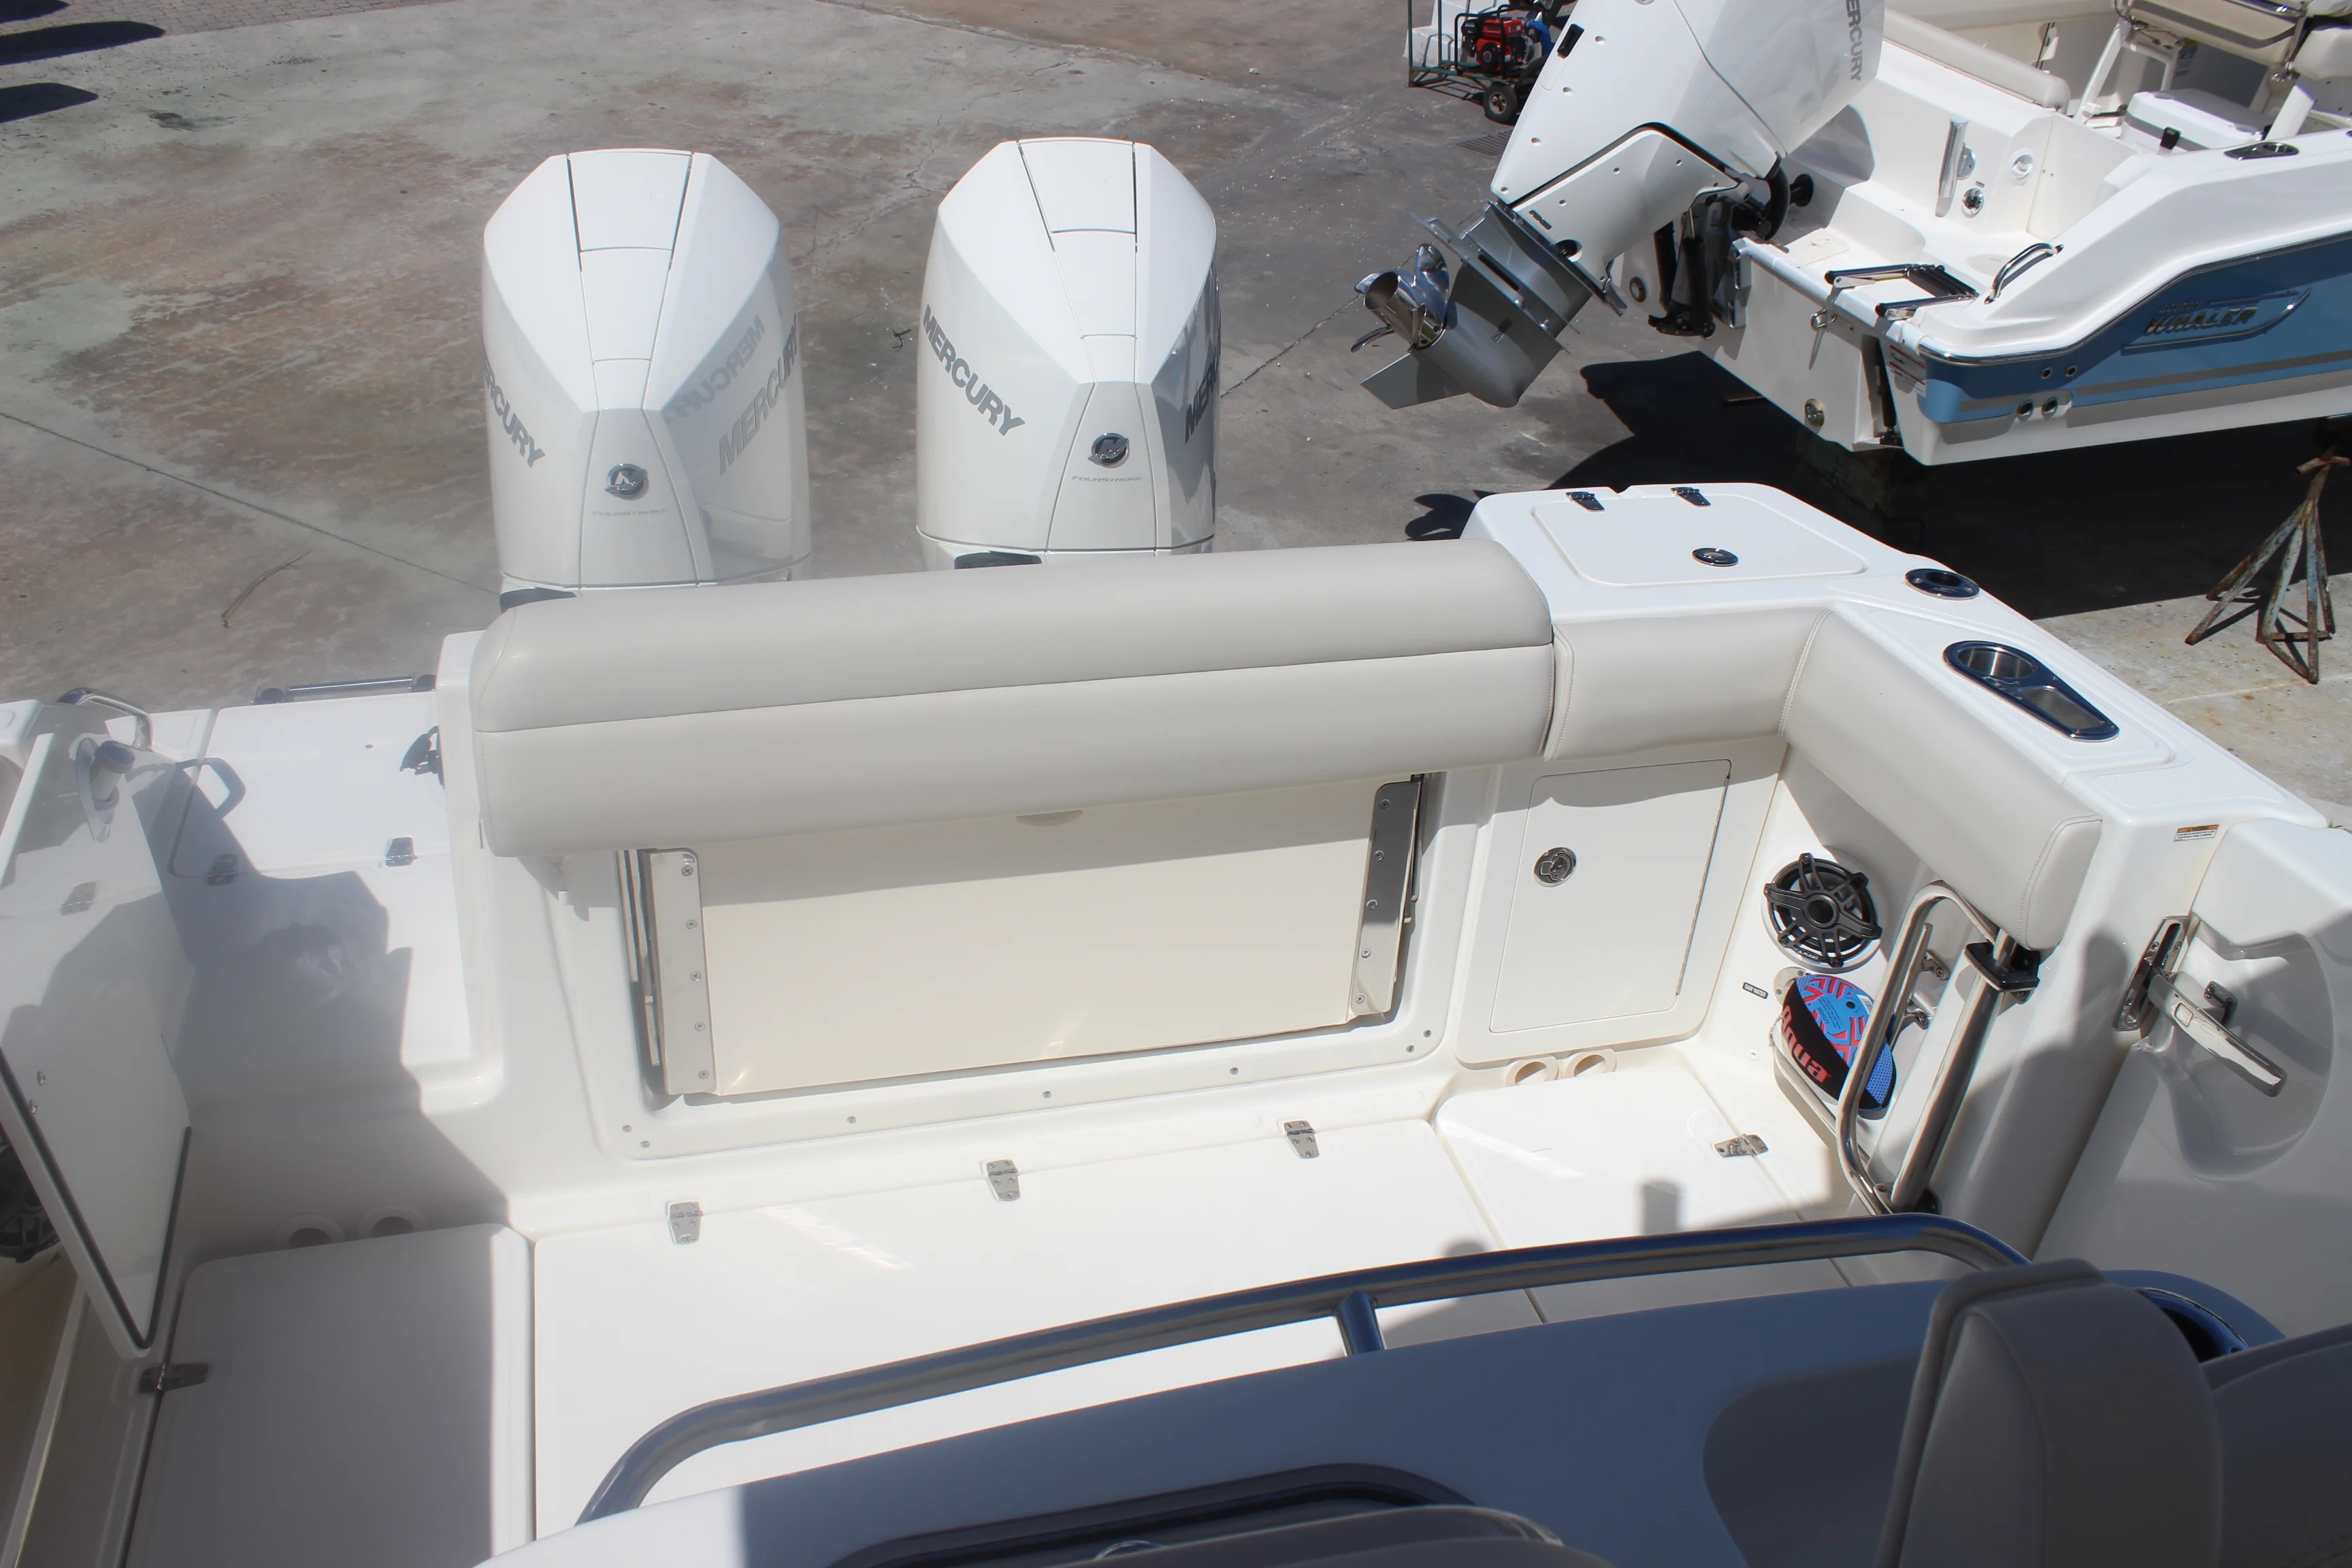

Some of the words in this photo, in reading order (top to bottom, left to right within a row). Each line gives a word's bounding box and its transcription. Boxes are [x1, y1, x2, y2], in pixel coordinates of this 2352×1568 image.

[1845, 0, 1863, 81] ERCURY
[2144, 306, 2259, 333] WHALER
[923, 303, 1026, 437] MERCURY
[485, 359, 546, 468] ERCURY
[1803, 951, 1818, 960] AUDIO
[1752, 986, 1767, 998] WATER
